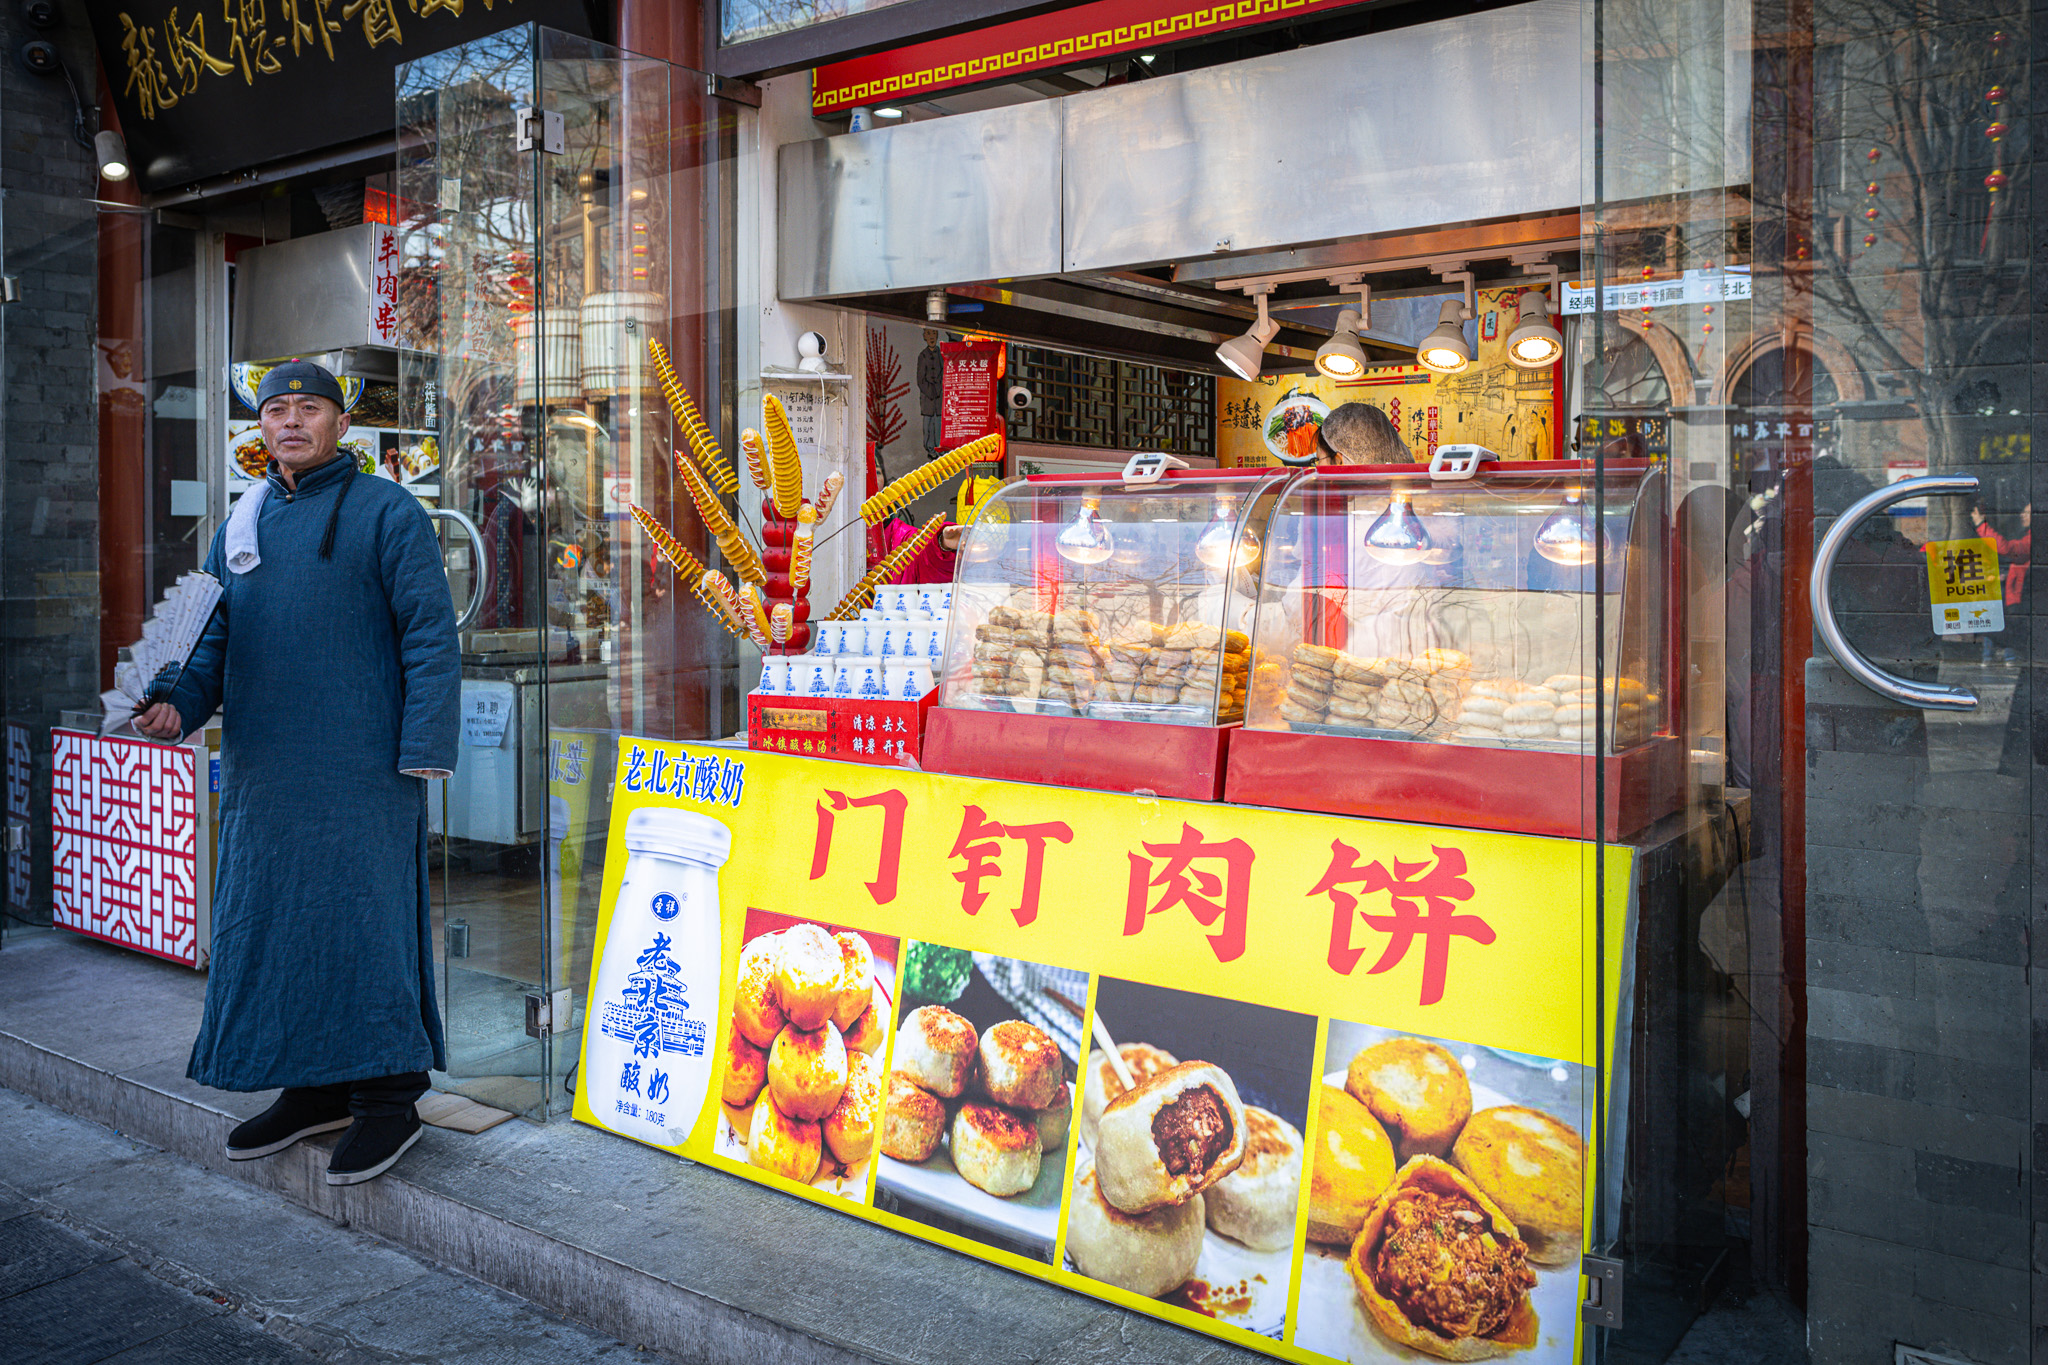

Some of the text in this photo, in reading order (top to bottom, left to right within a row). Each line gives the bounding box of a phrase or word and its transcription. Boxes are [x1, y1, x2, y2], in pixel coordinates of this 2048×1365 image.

[374, 230, 398, 341] 羊肉串
[1943, 548, 1984, 585] 推
[1946, 585, 1986, 597] PUSH
[476, 701, 499, 716] 招聘
[852, 713, 907, 733] 清凉 去火
[763, 735, 827, 754] 冰镇酸梅汤
[852, 736, 905, 757] 解暑 开胃
[622, 745, 745, 807] 老北京酸奶
[809, 788, 1497, 1006] 门钉肉饼
[634, 931, 671, 1059] 老北京
[620, 1060, 670, 1105] 酸奶
